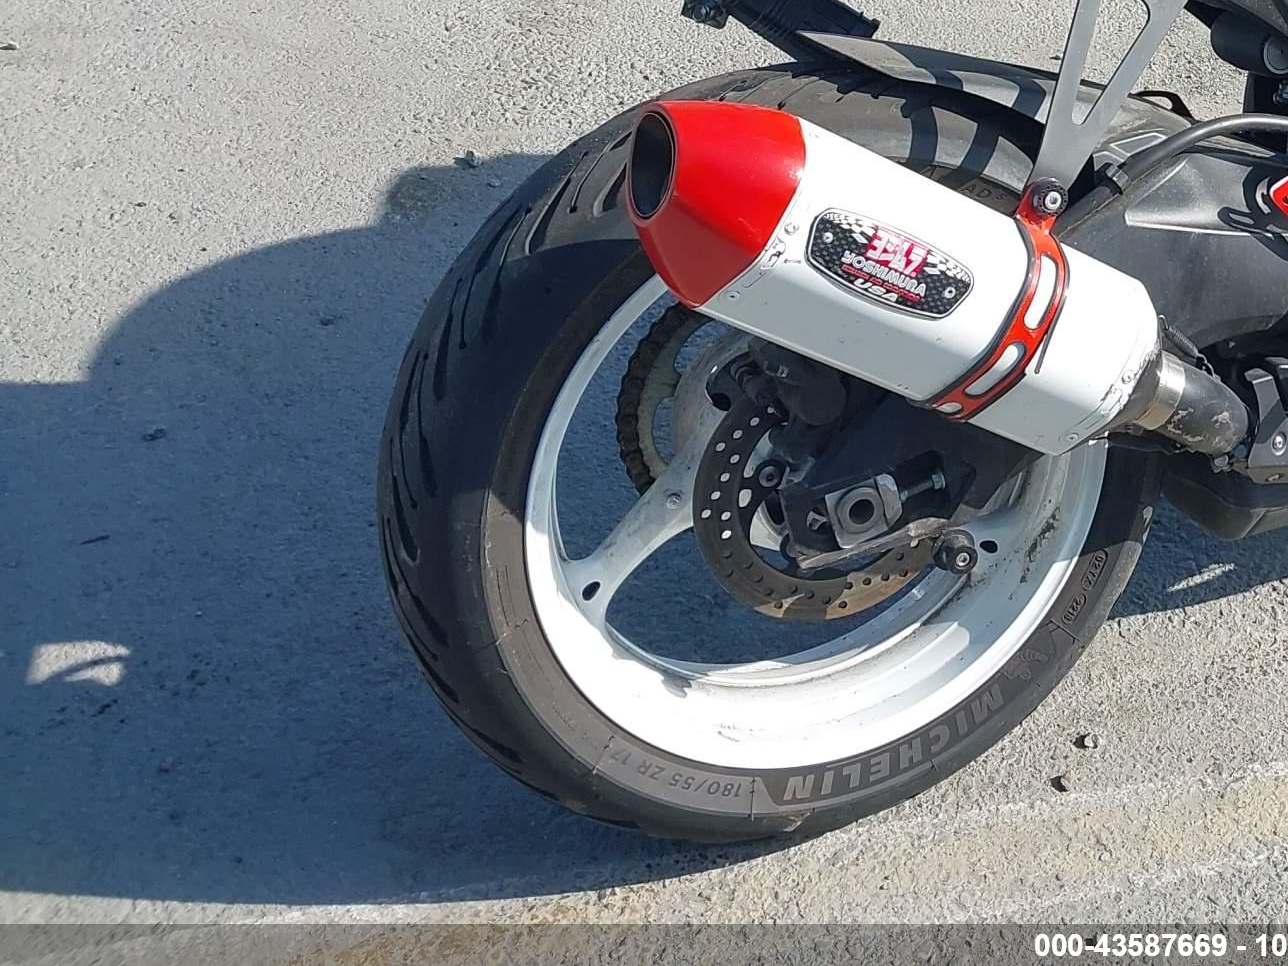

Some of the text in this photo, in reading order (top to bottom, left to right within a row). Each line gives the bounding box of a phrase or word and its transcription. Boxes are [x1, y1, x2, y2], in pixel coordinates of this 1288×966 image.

[841, 250, 926, 297] YOSHIMURA
[853, 279, 898, 302] USA
[783, 684, 1005, 801] MICHELIN
[637, 759, 668, 781] ZR
[668, 772, 743, 798] 180/55
